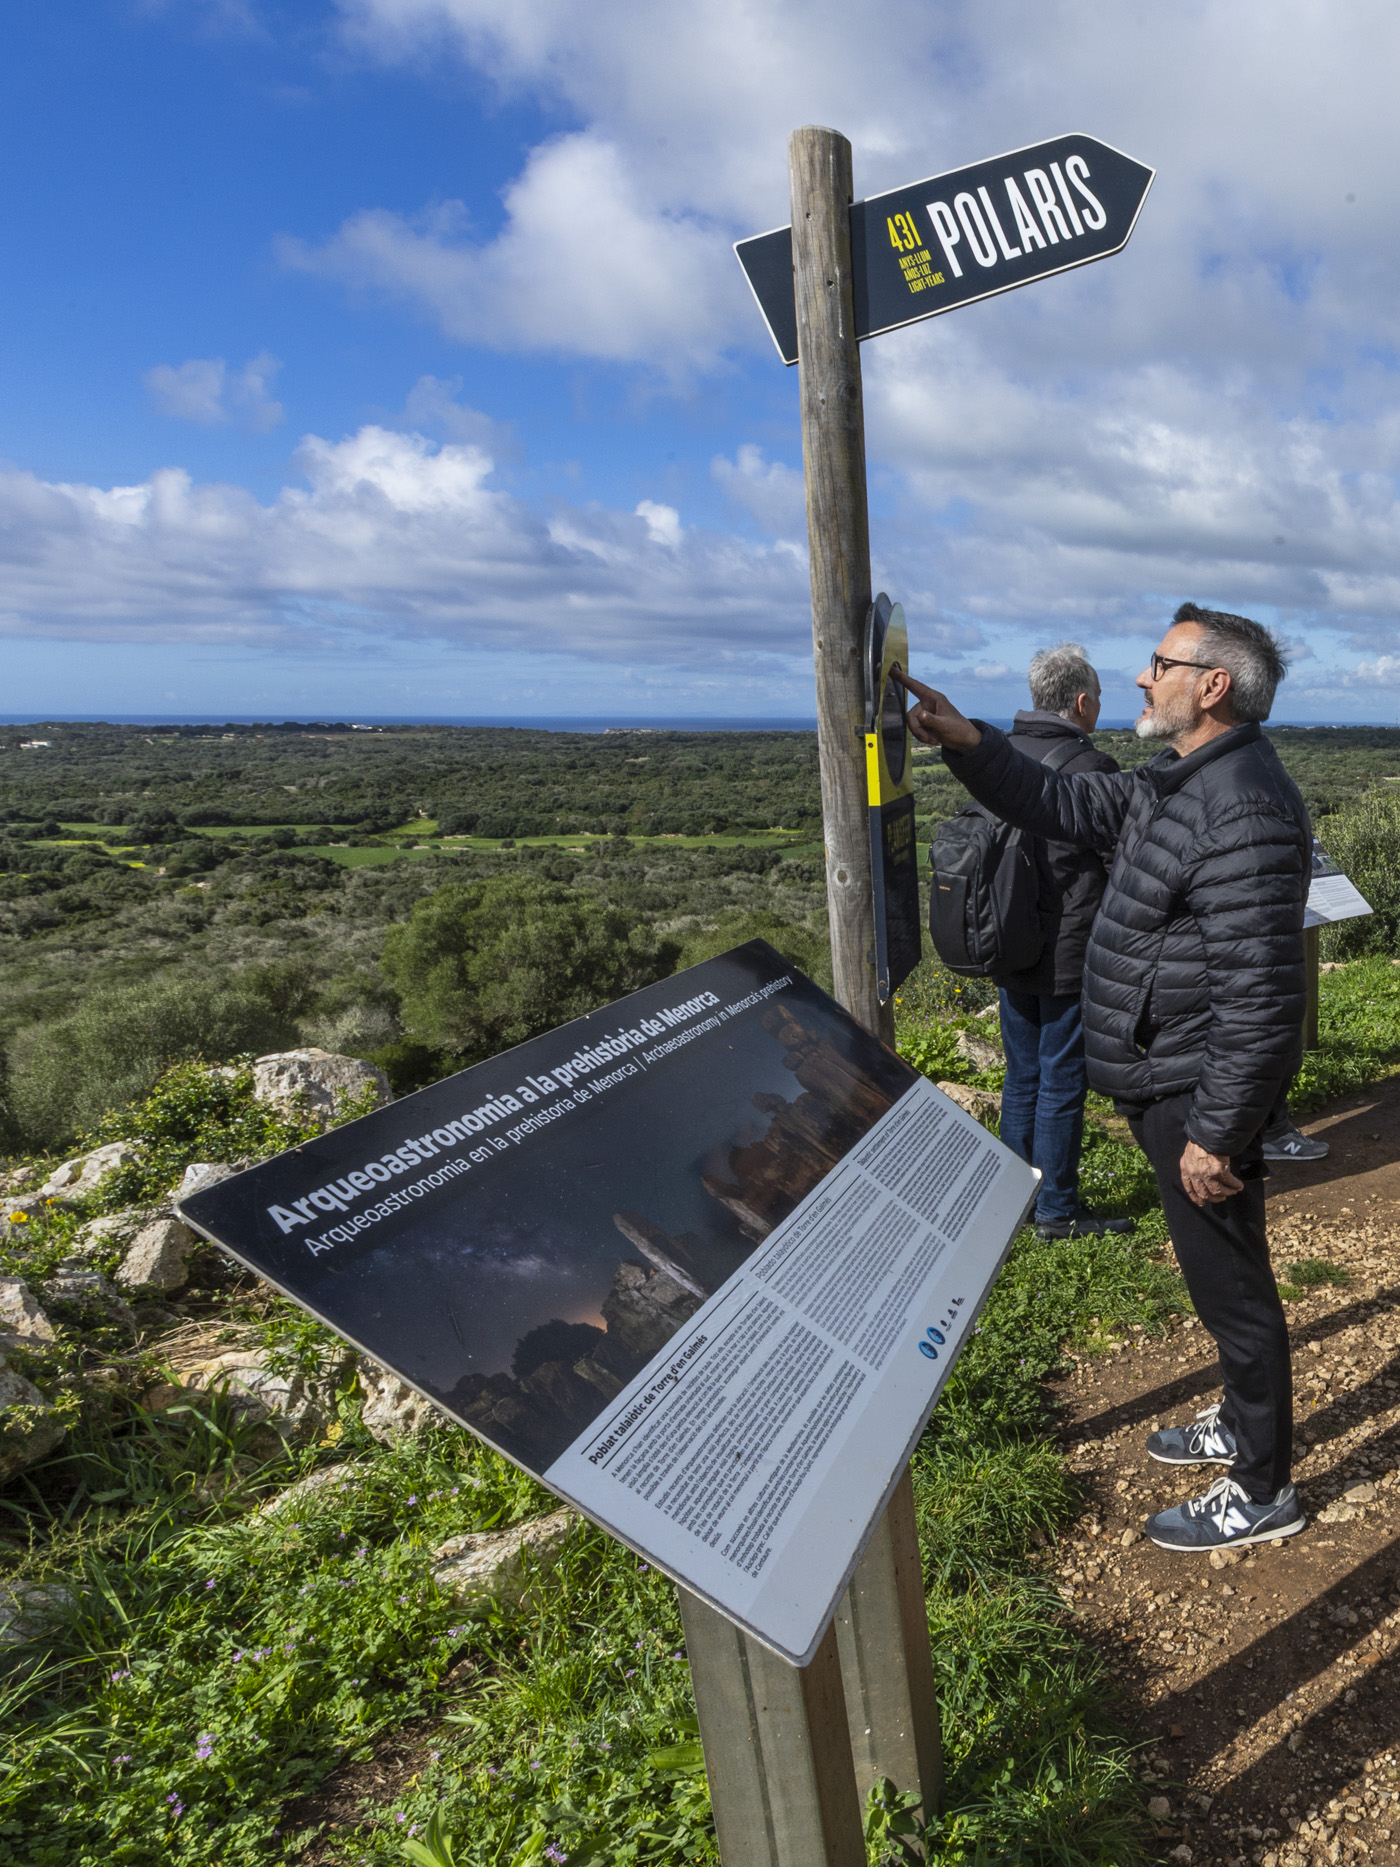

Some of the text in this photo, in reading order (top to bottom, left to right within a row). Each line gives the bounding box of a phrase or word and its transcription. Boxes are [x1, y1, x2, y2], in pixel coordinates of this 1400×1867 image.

[887, 211, 922, 252] 431
[926, 155, 1107, 278] POLARIS
[898, 249, 931, 270] ANYS-LLUM
[903, 262, 932, 282] AÑOS-LUZ
[907, 271, 945, 293] LIGHT-YEARS
[267, 991, 721, 1234] Arqueoastronomia a la prehistòria de Menorca
[304, 1158, 472, 1257] Arqueoastronomia
[468, 1145, 494, 1163] en
[485, 1136, 510, 1151] la
[504, 1098, 577, 1145] prehistoria
[572, 1089, 593, 1104] de
[586, 1063, 639, 1094] Menorca
[641, 1015, 722, 1065] Archaeoastronomy
[714, 1010, 730, 1022] in
[724, 991, 763, 1017] Menorca's
[759, 975, 793, 1000] prehistory
[886, 1125, 896, 1133] Torre
[755, 1258, 776, 1279] Poblado
[773, 1237, 795, 1260] talayótico
[797, 1220, 811, 1232] Torre
[808, 1211, 819, 1221] d'en
[815, 1196, 831, 1212] Galmés
[587, 1334, 707, 1464] Poblat talaiòtic de Torre d'en Galmés
[614, 1452, 634, 1473] Menorca
[641, 1419, 662, 1442] identificat
[660, 1411, 669, 1420] una
[666, 1395, 683, 1412] trentena
[619, 1468, 633, 1483] tenen
[647, 1438, 658, 1450] amb
[659, 1422, 671, 1436] porta
[639, 1471, 655, 1489] recinte
[657, 1452, 670, 1465] Torre
[694, 1406, 707, 1420] temps
[643, 1480, 660, 1501] possible
[695, 1424, 703, 1433] del
[659, 1440, 668, 1449] des
[675, 1417, 687, 1431] petita
[654, 1490, 671, 1509] Estudis
[668, 1473, 684, 1492] recents
[670, 1480, 690, 1505] necessitat
[692, 1463, 702, 1475] tenir
[700, 1454, 709, 1464] una
[686, 1519, 696, 1531] amb
[692, 1511, 701, 1520] les
[716, 1478, 725, 1488] que
[726, 1448, 746, 1474] practicen
[689, 1483, 699, 1495] amb
[715, 1437, 732, 1459] visualitzar
[693, 1486, 709, 1505] aquesta
[706, 1468, 721, 1487] singular
[694, 1528, 701, 1536] de
[705, 1511, 713, 1519] de
[729, 1471, 741, 1483] Terra
[701, 1525, 714, 1541] deixar
[711, 1519, 719, 1527] de
[716, 1506, 728, 1520] veure
[749, 1458, 759, 1473] partir
[720, 1543, 731, 1555] Com
[729, 1521, 745, 1544] succeeix
[747, 1501, 758, 1515] altres
[756, 1483, 770, 1501] cultures
[768, 1464, 782, 1484] antigues
[728, 1529, 751, 1562] menorquines
[747, 1516, 759, 1531] fossin
[755, 1489, 776, 1518] identificades
[773, 1480, 782, 1491] amb
[751, 1523, 766, 1542] trobada
[766, 1502, 778, 1519] recinte
[779, 1485, 789, 1497] taula
[762, 1530, 771, 1540] Cal
[772, 1516, 780, 1526] que
[780, 1496, 792, 1513] mestre
